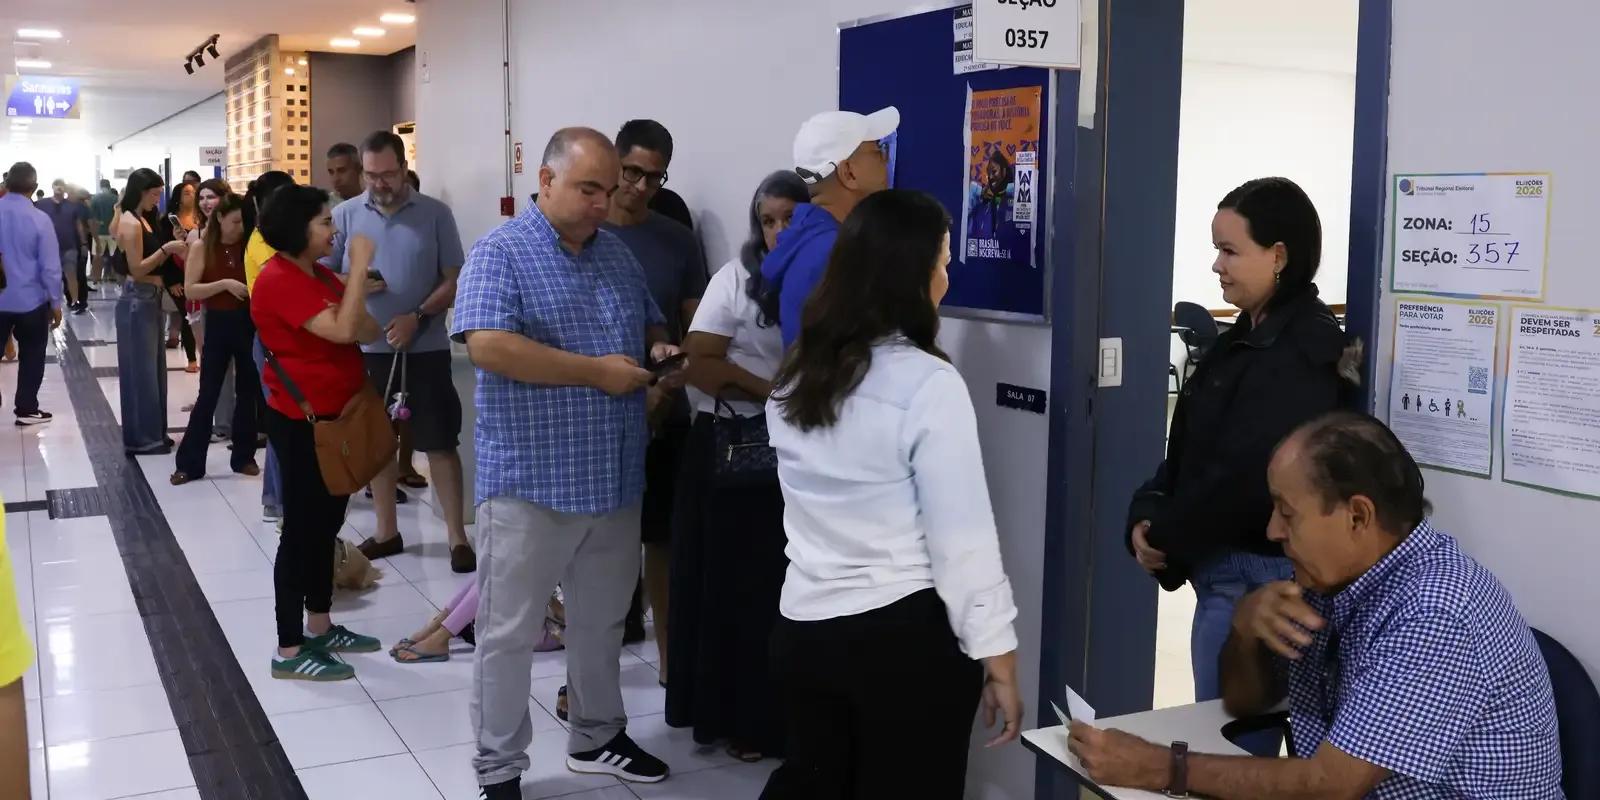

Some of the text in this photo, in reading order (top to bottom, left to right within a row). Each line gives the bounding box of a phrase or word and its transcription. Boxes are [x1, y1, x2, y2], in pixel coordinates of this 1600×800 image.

[1005, 28, 1049, 49] 0357
[1515, 186, 1543, 195] 2026
[1403, 213, 1491, 235] ZONA: 15
[979, 238, 999, 248] BRASÍLIA
[1402, 240, 1520, 266] SEÇÃO: 357
[1400, 303, 1444, 313] PREFERÊNCIA
[1420, 312, 1444, 320] VOTAR
[1468, 315, 1494, 325] 2026
[1520, 317, 1551, 326] DEVEM
[1553, 320, 1571, 328] SER
[1520, 326, 1581, 337] RESPEITADAS
[1007, 390, 1035, 403] SALA 07
